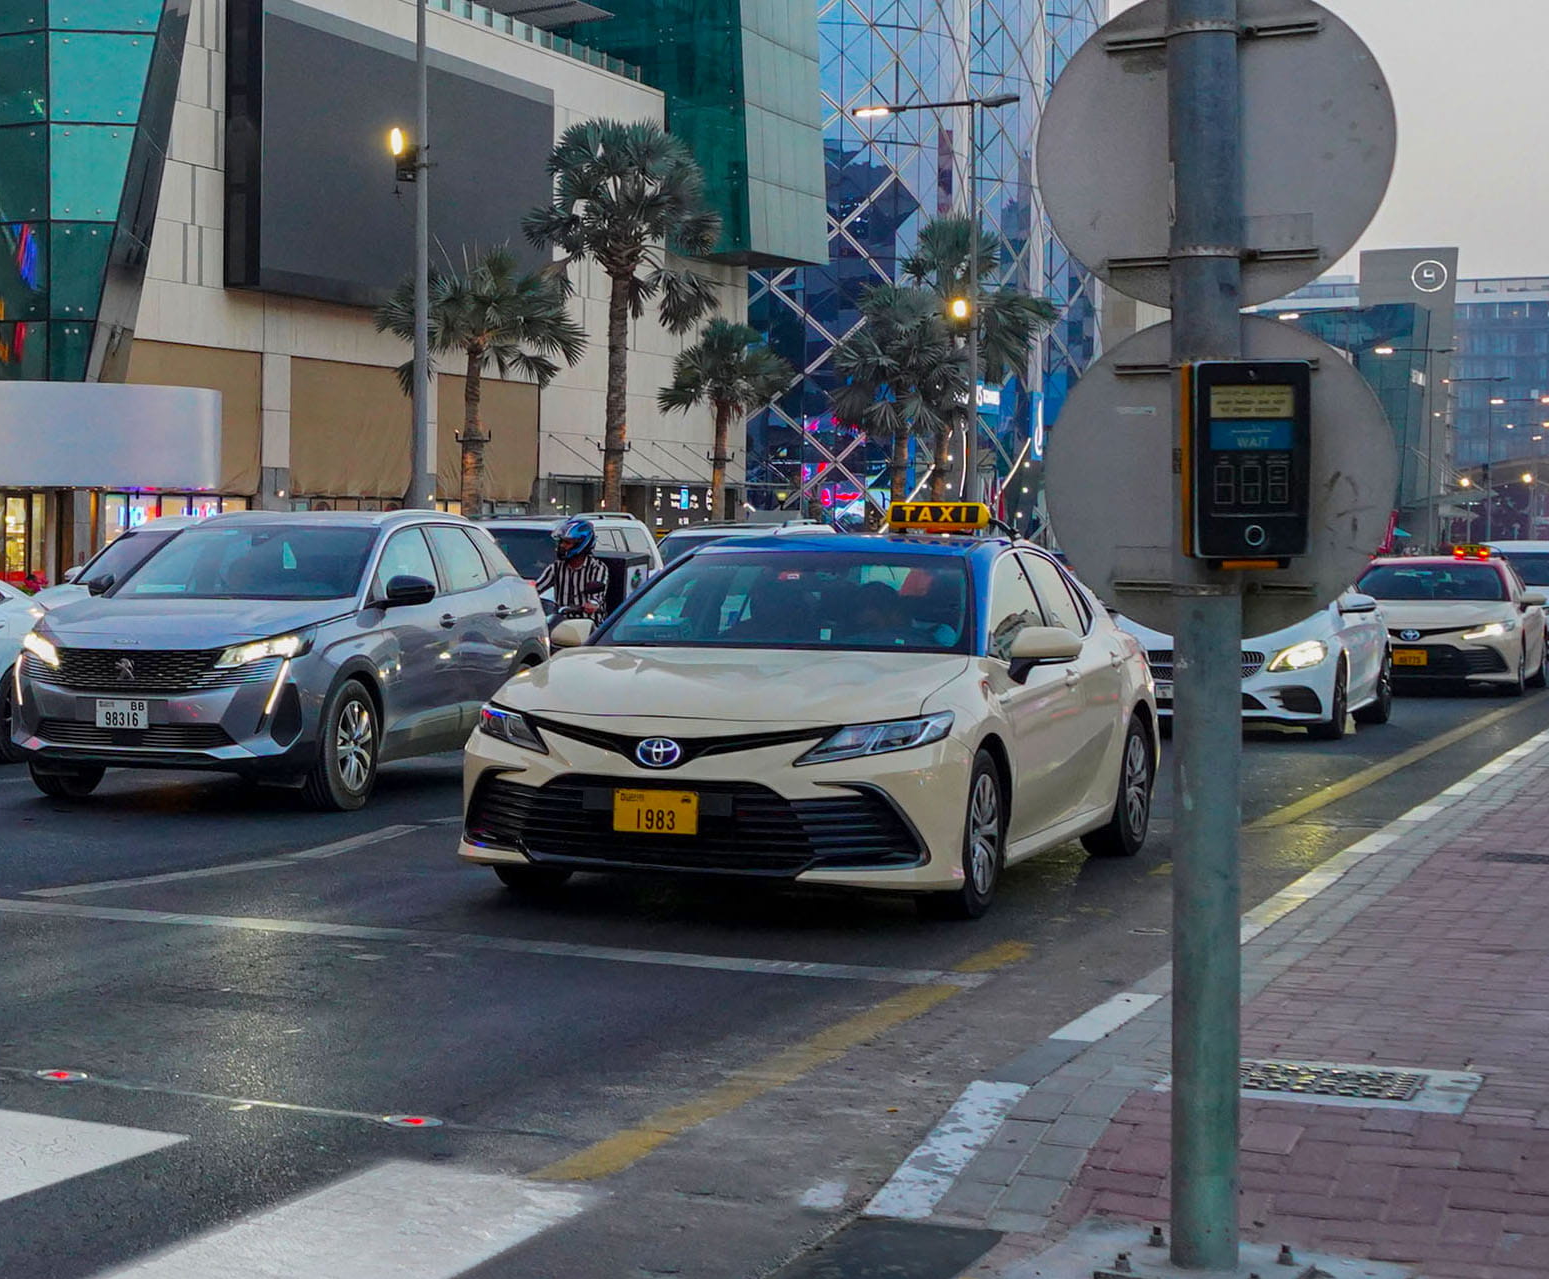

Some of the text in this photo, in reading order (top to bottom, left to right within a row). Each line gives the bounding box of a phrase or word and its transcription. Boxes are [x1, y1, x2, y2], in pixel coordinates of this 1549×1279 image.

[1236, 436, 1270, 448] WAIT
[902, 506, 967, 522] TAXI
[130, 701, 145, 711] BB
[105, 711, 139, 727] 98316
[636, 808, 676, 831] 1983
